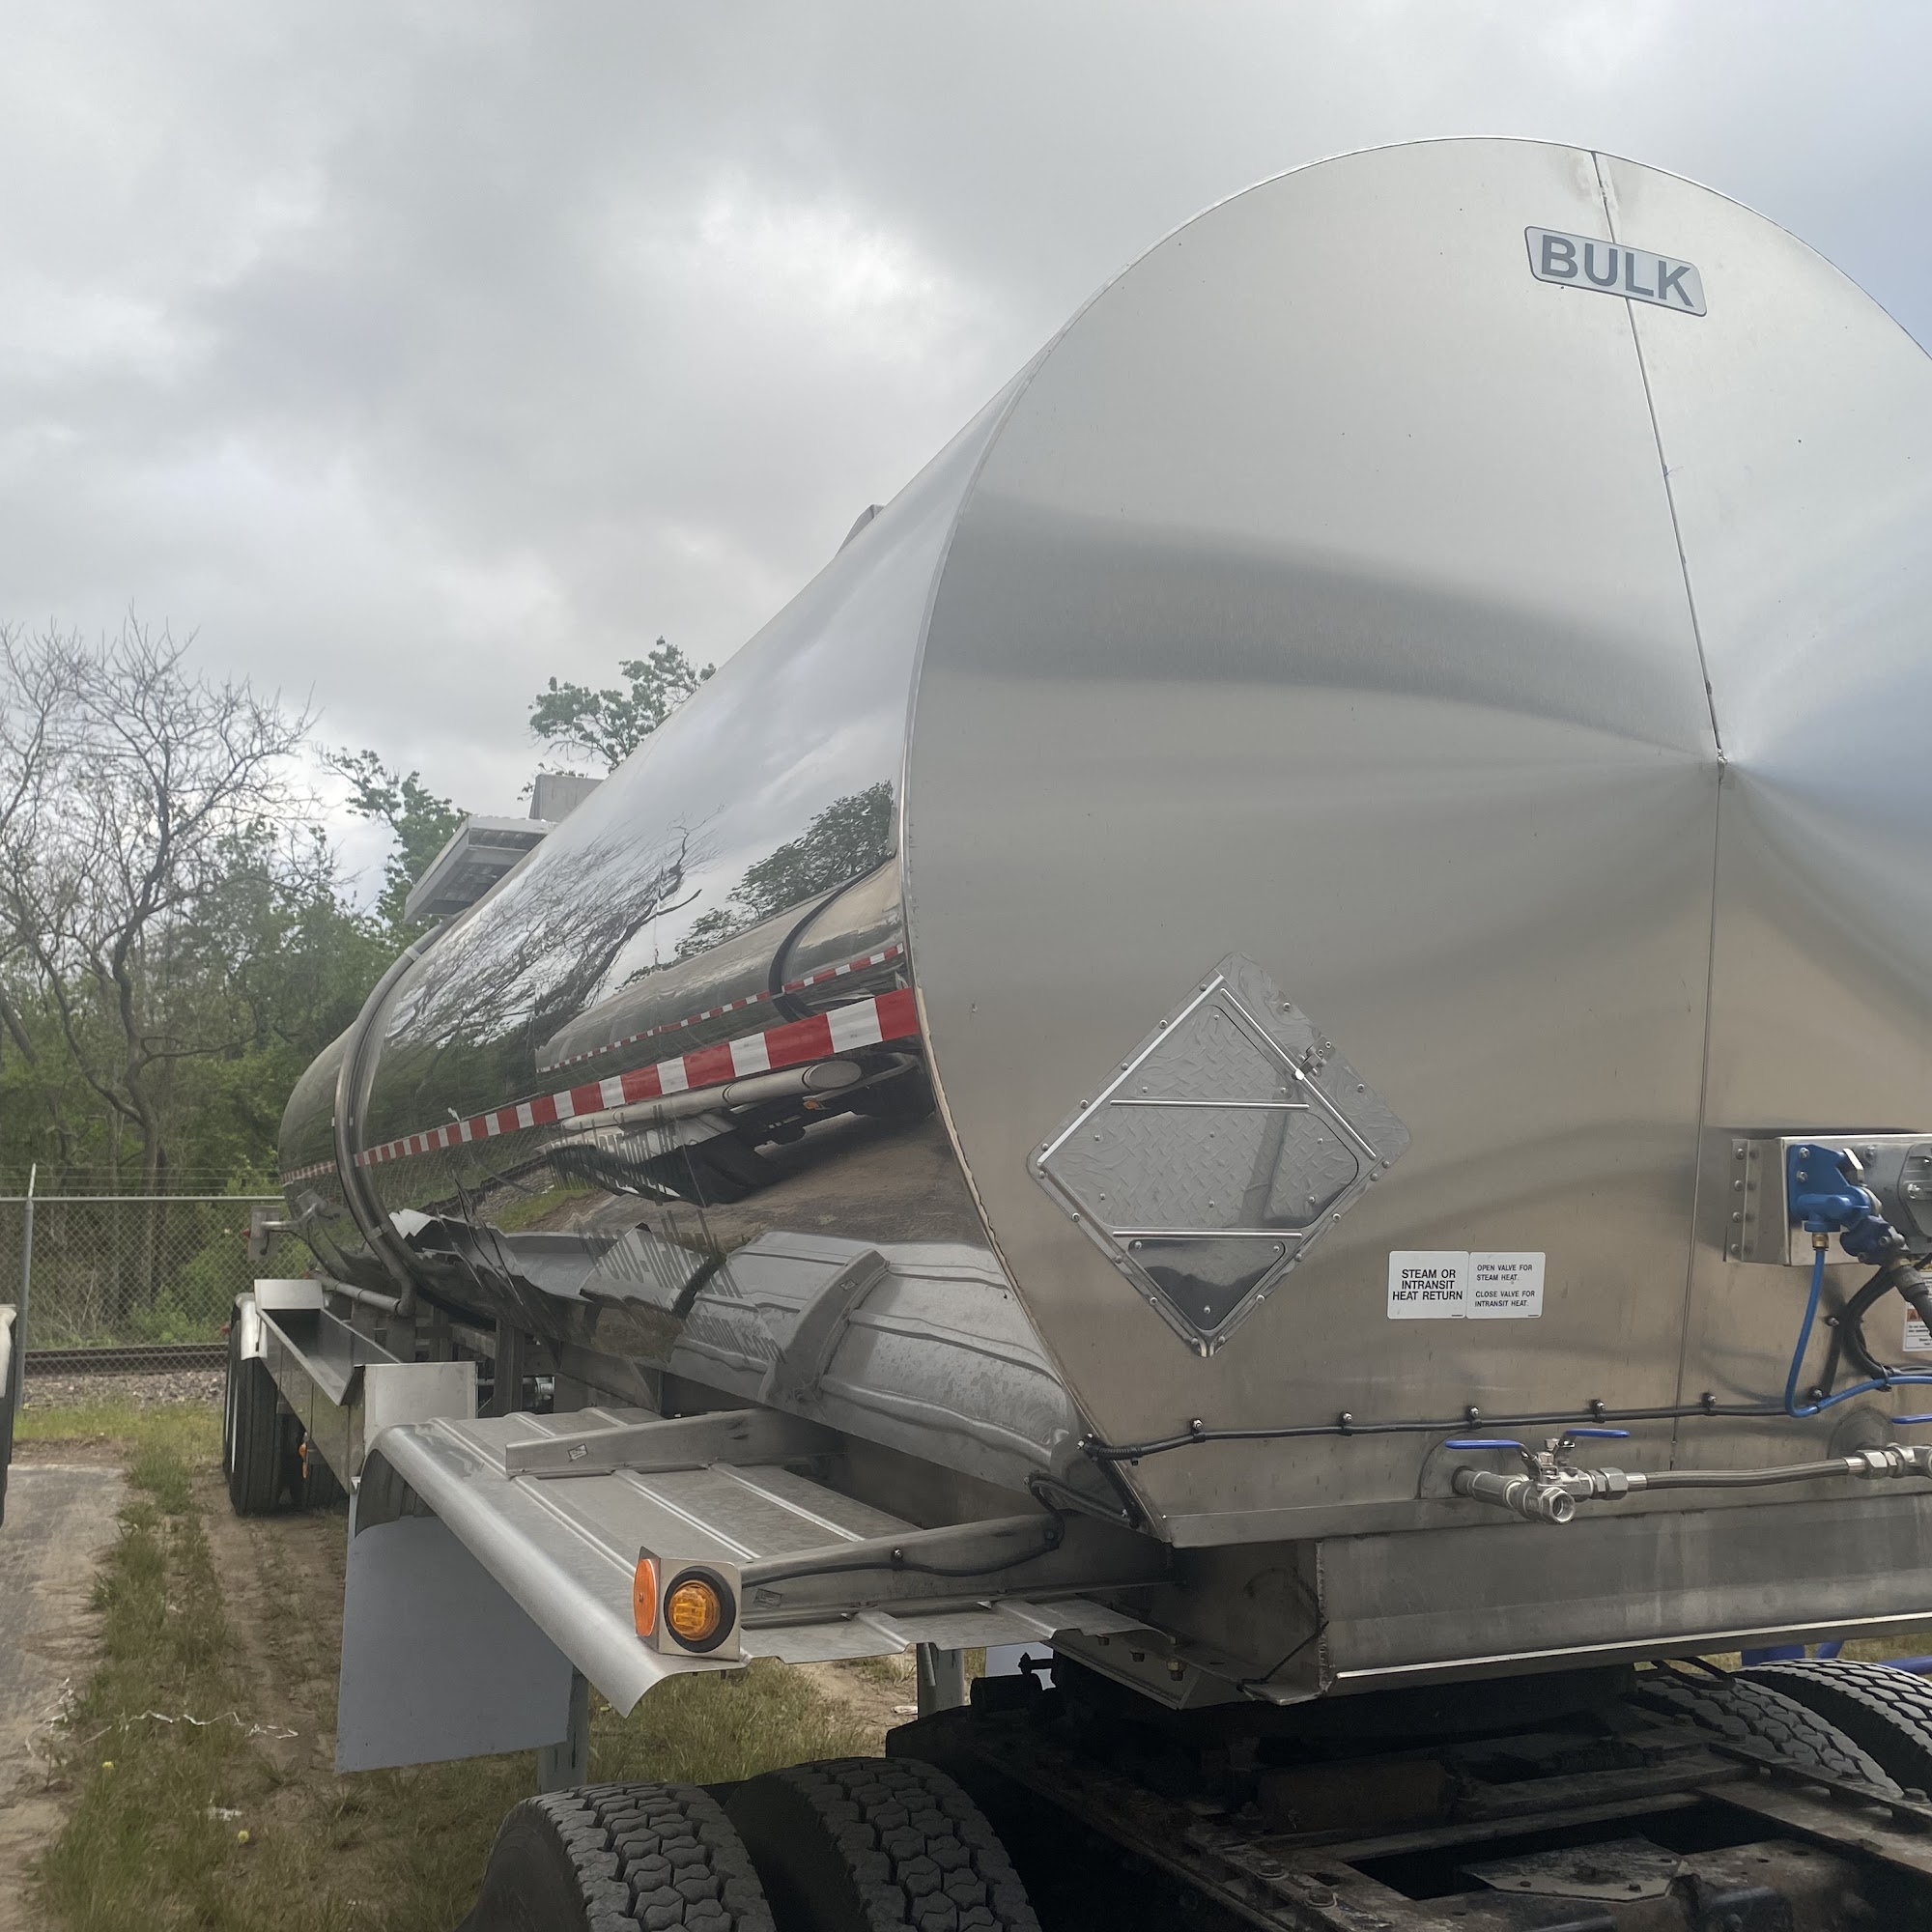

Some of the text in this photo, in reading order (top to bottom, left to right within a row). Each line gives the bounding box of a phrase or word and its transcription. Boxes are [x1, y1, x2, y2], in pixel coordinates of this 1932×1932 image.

[1542, 235, 1694, 307] BULK
[1402, 1268, 1456, 1278] STEAM OR
[1402, 1280, 1455, 1290] INTRANSIT
[1392, 1291, 1463, 1300] HEAT RETURN
